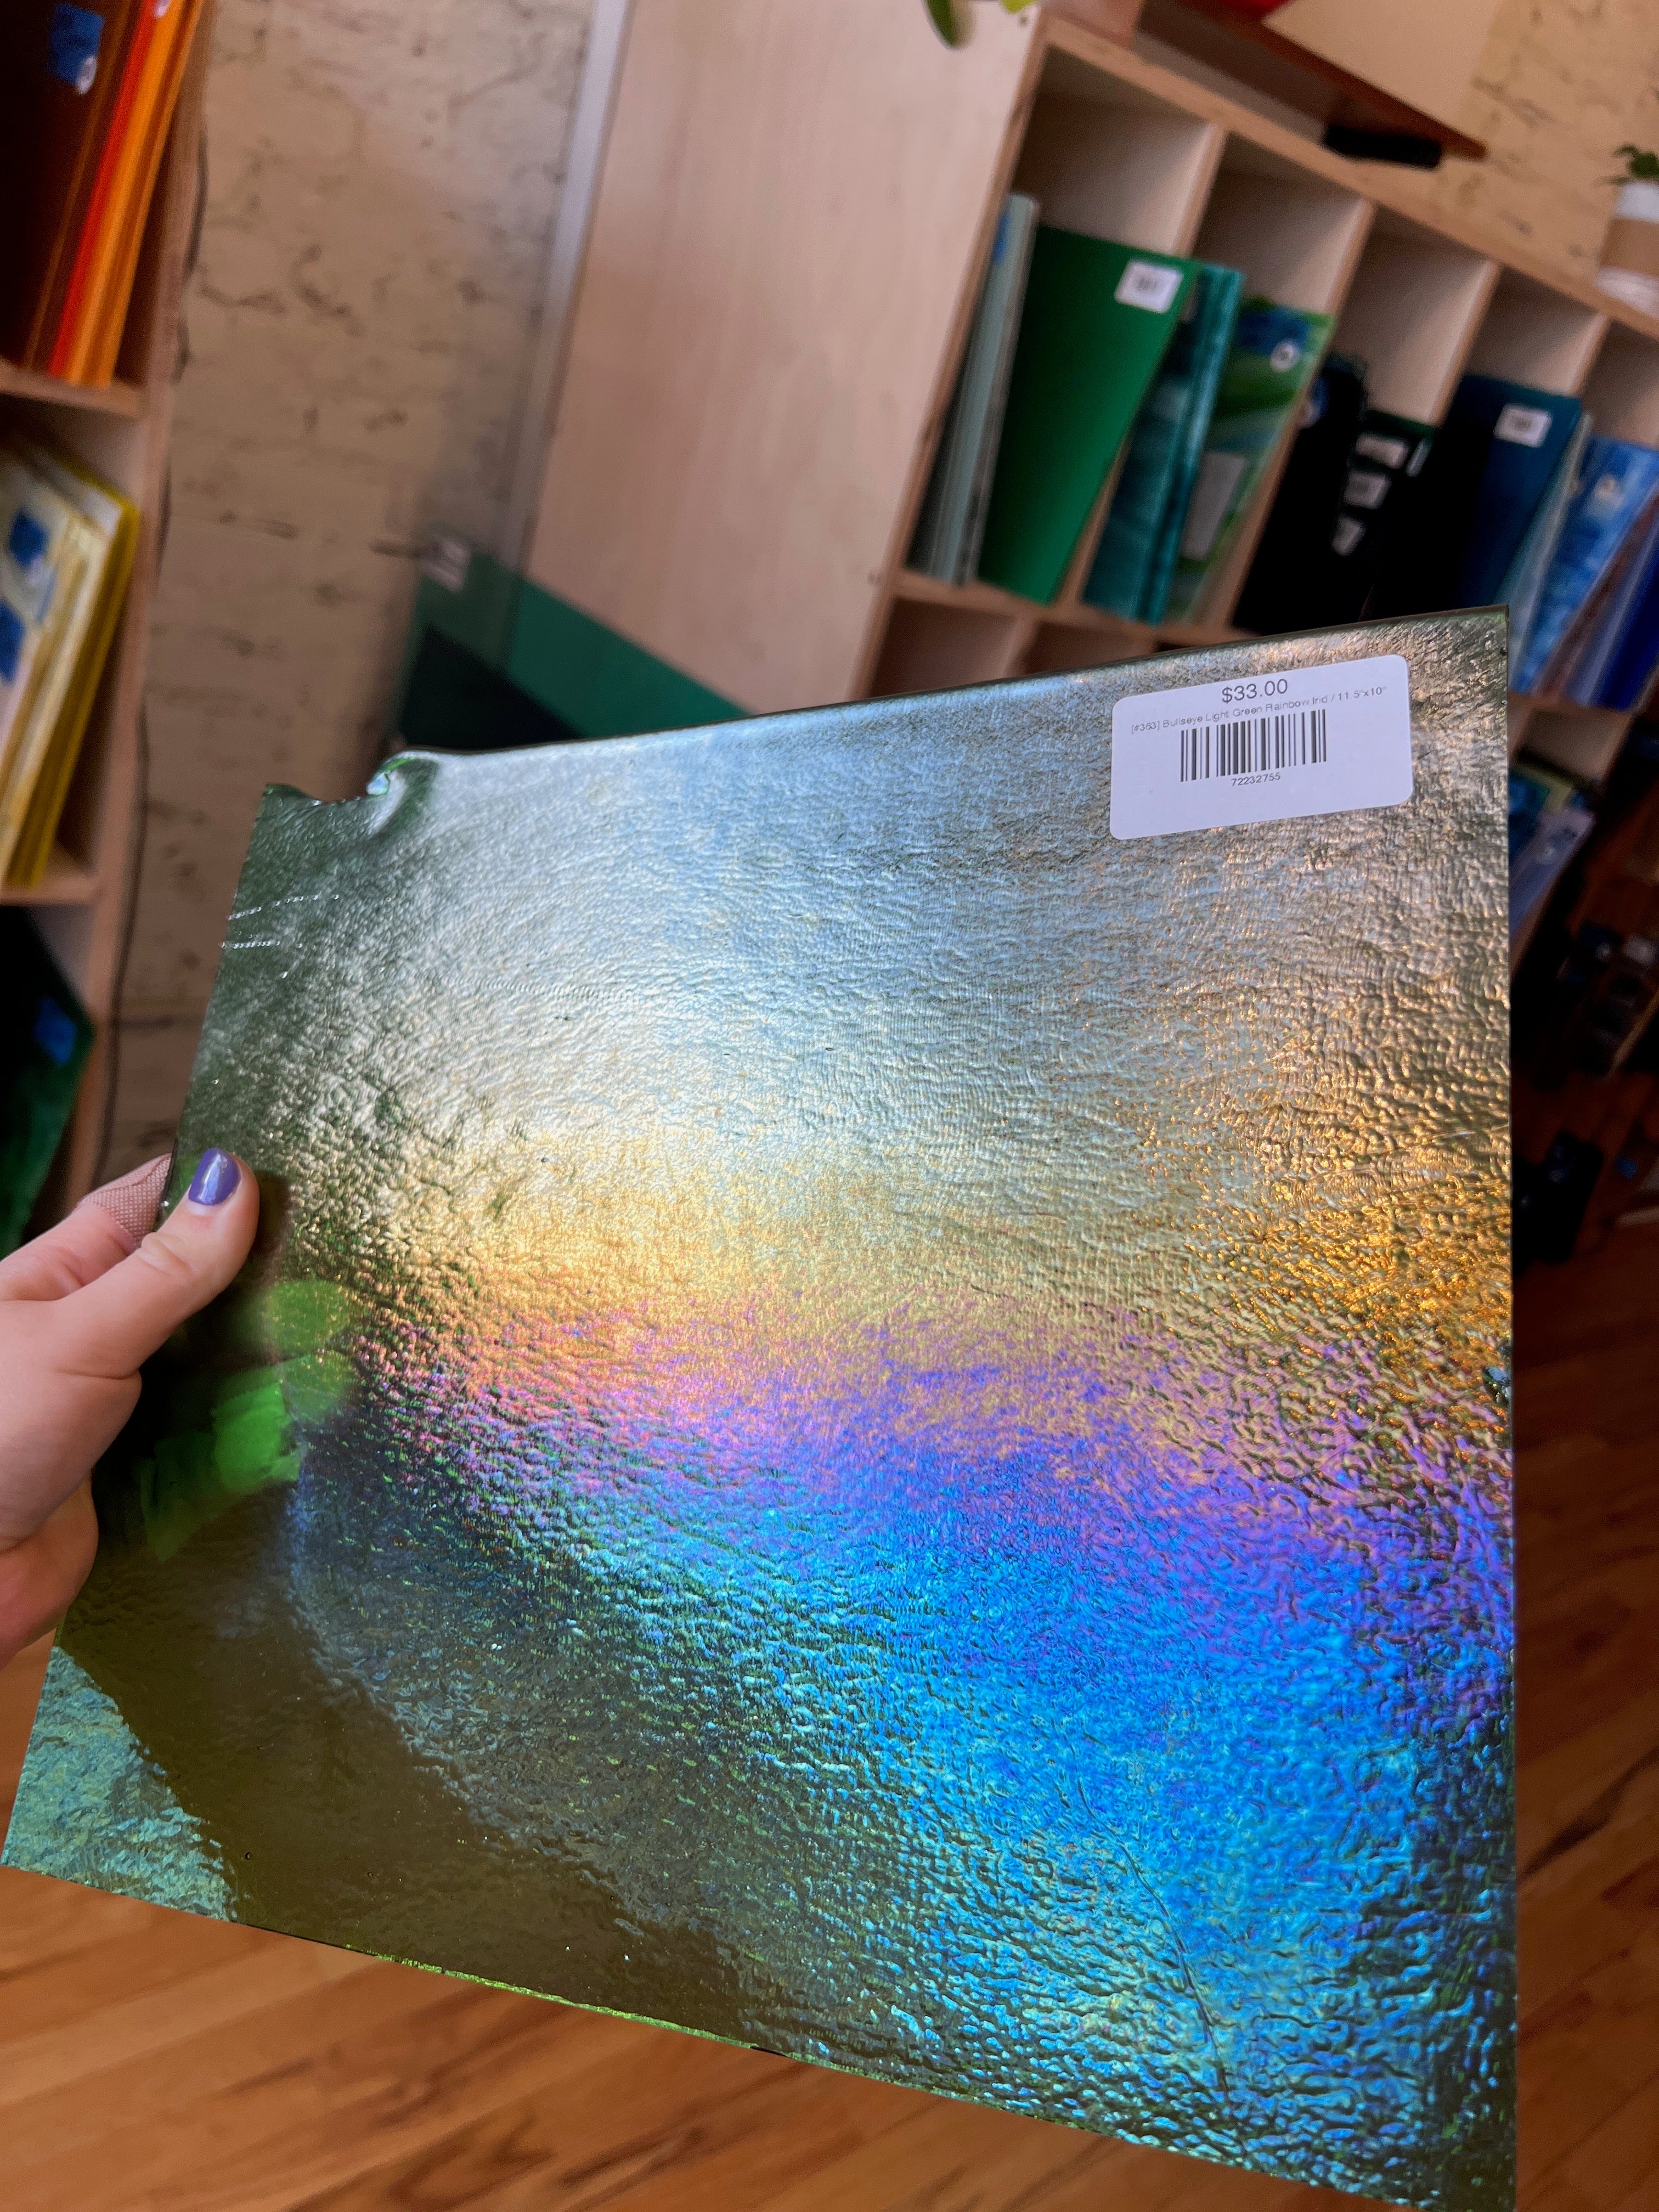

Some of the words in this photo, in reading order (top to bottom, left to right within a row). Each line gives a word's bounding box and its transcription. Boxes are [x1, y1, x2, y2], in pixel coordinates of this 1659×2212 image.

[1222, 679, 1288, 704] $33.00
[1131, 721, 1160, 734] [#363]
[1163, 715, 1203, 728] Bullseye
[1205, 709, 1229, 722] Light
[1232, 707, 1261, 716] Green
[1265, 699, 1310, 712] Rainbow
[1312, 695, 1328, 705] Irid
[1338, 686, 1387, 701] 115"x10"
[1231, 772, 1280, 787] 72232755
